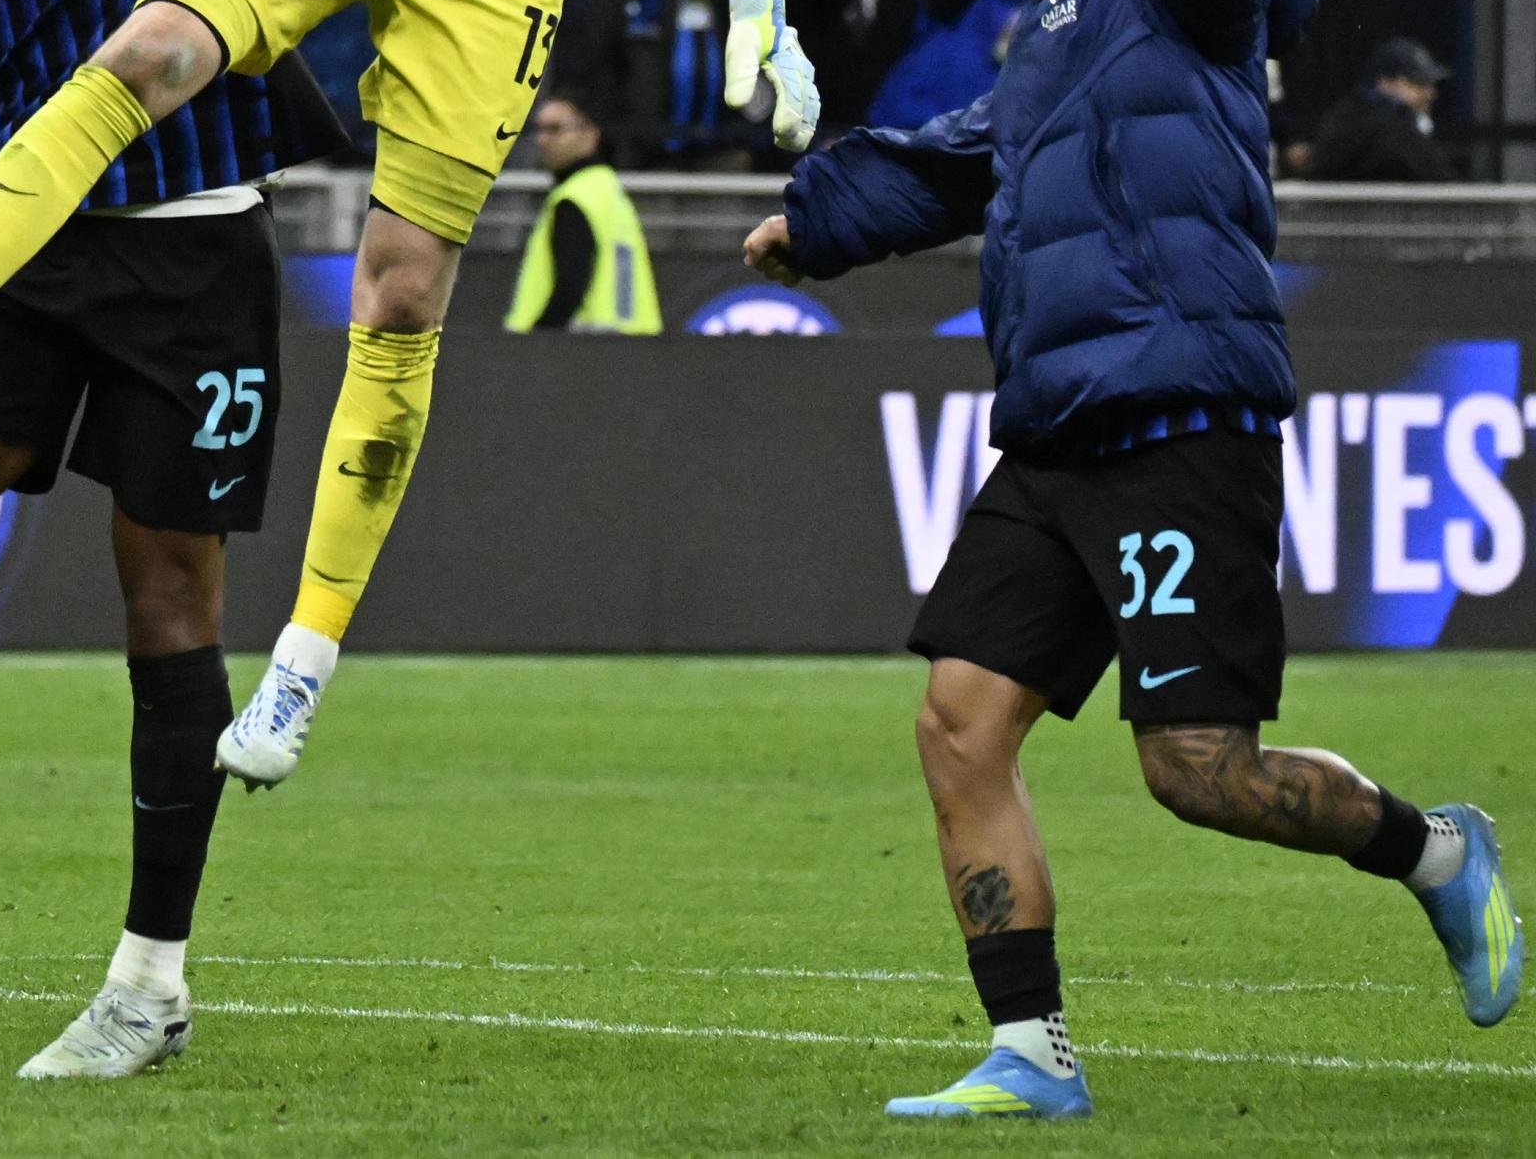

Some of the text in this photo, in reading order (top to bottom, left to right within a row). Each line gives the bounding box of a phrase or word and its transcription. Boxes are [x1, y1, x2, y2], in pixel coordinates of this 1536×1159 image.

[1041, 0, 1076, 28] QATAR
[192, 368, 266, 449] 25
[1119, 529, 1195, 619] 32
